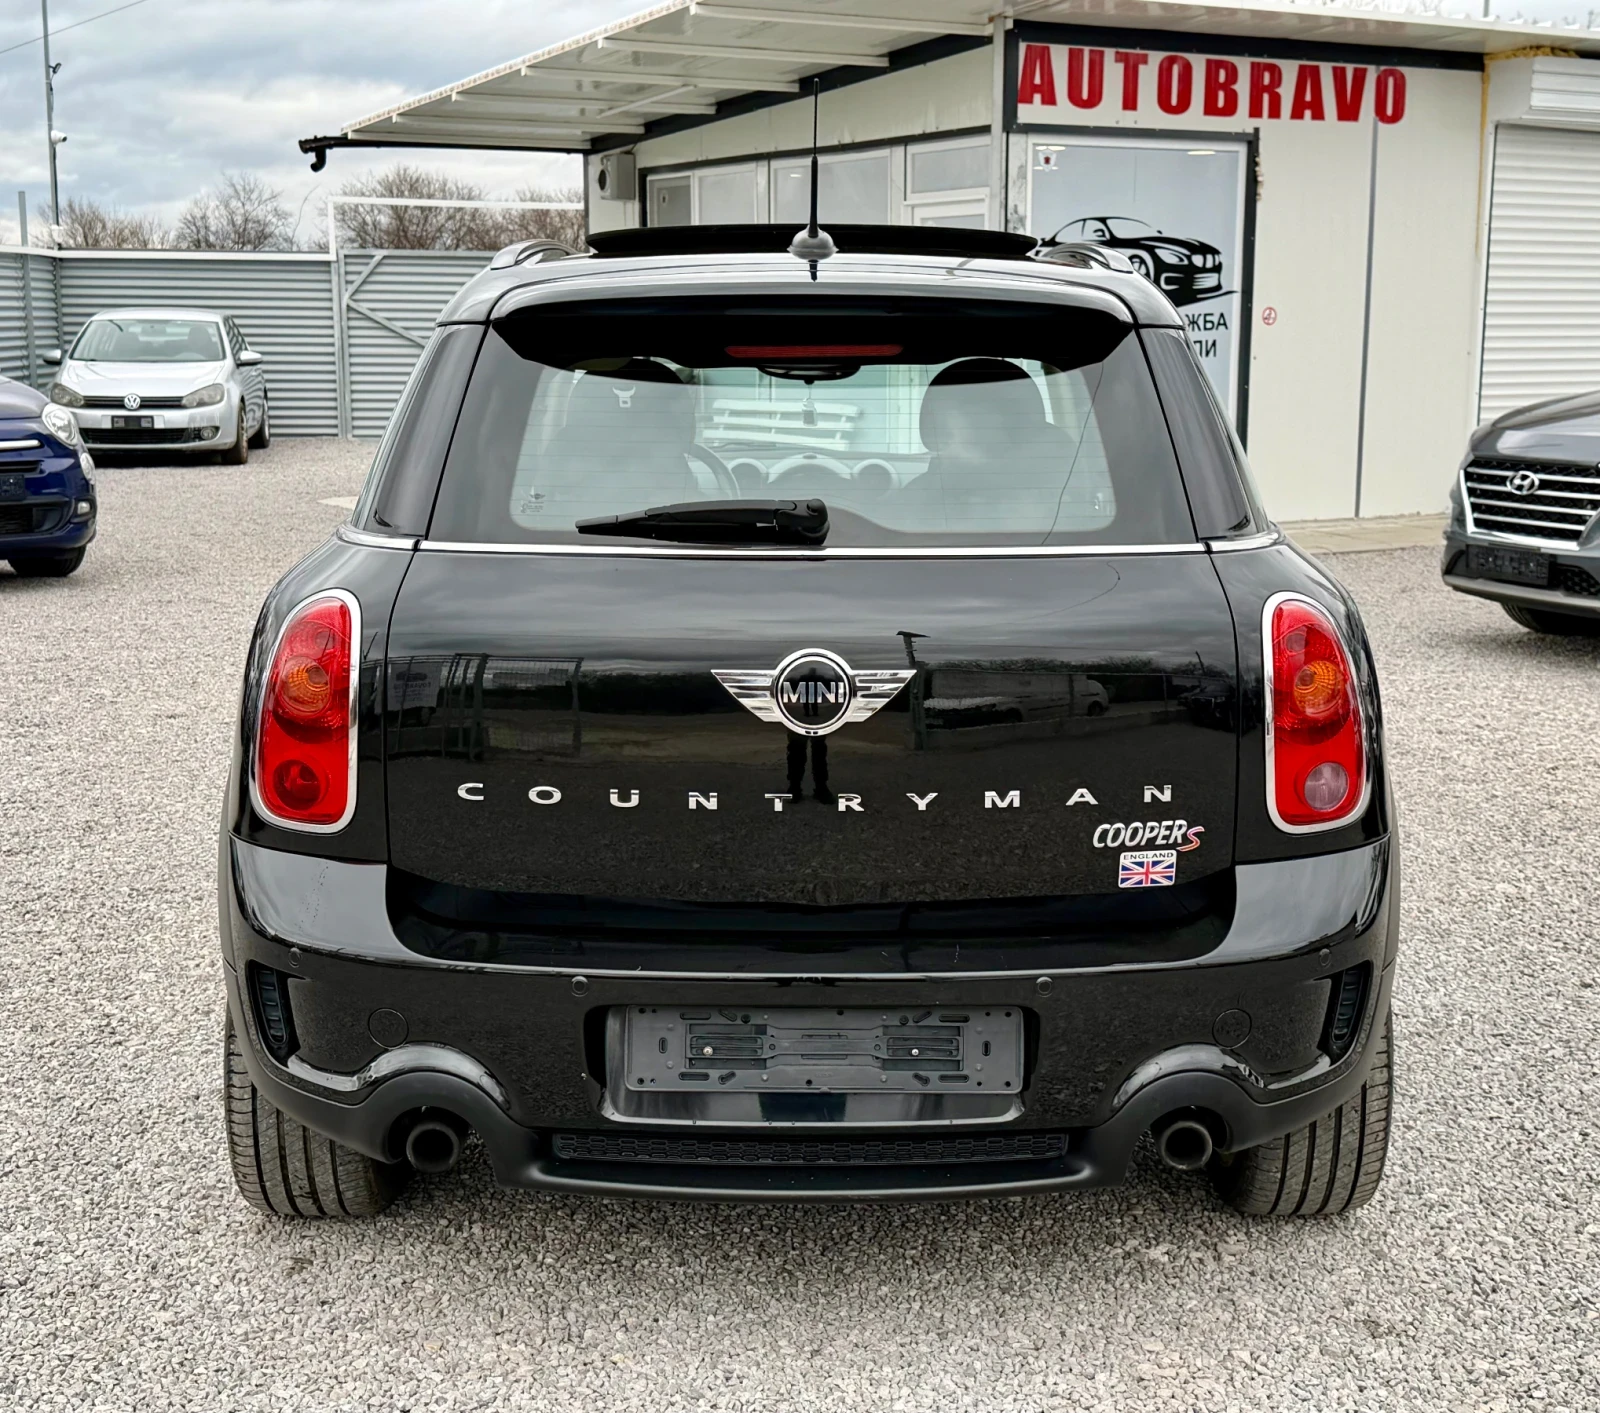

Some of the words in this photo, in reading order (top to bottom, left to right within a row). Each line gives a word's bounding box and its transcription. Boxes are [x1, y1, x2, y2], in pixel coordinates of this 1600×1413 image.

[1018, 44, 1407, 124] AUTOBRAVO
[783, 681, 845, 704] MINI
[457, 783, 1172, 812] COUNTRYMAN
[1123, 852, 1174, 860] ENGLAND
